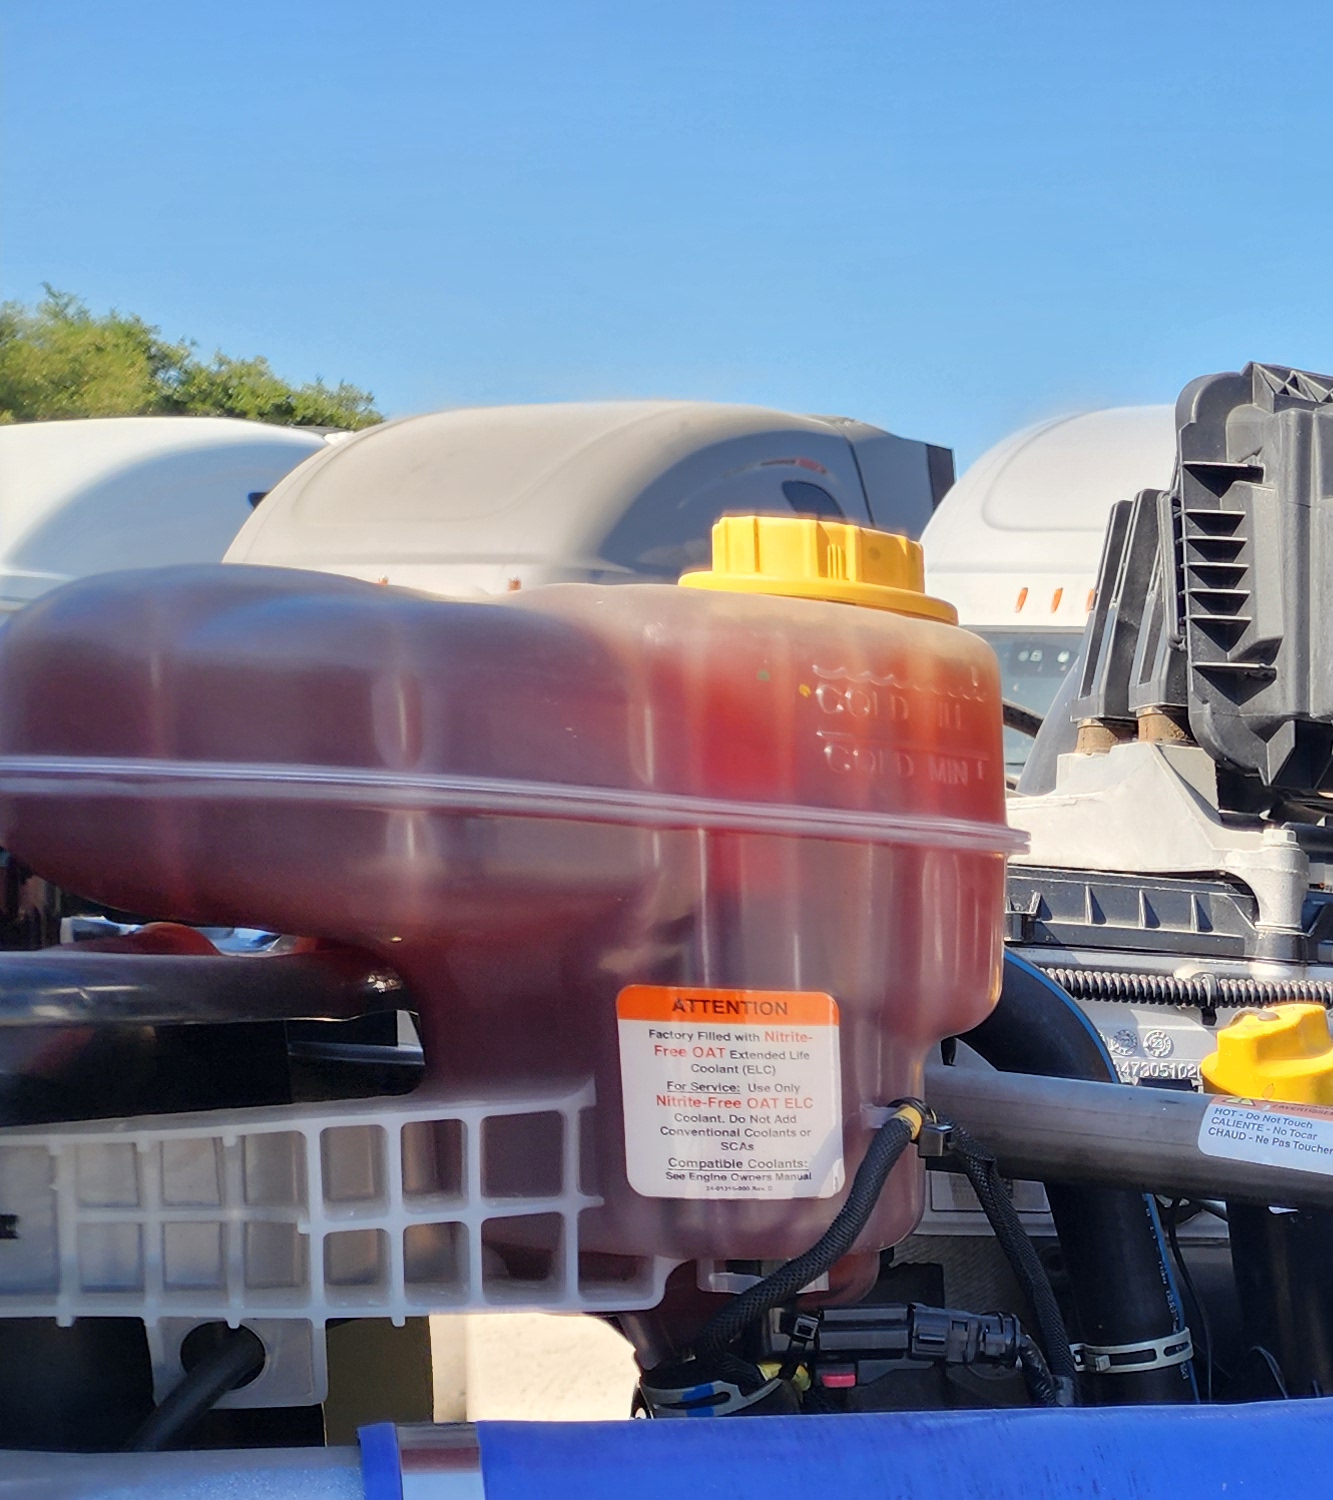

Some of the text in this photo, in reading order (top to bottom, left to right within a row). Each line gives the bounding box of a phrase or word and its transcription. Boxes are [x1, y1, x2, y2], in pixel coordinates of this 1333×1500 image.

[927, 754, 969, 787] MIN
[672, 998, 788, 1016] ATTENTION
[648, 1029, 813, 1044] Factory Filled with Nitrite-
[653, 1044, 810, 1061] Free OAT Extended Life
[690, 1063, 777, 1077] Coolant (ELC)
[666, 1081, 801, 1095] For Service: Use Only
[655, 1095, 814, 1109] Nitrite-Free OAT ELC
[674, 1113, 798, 1125] Coolant. Do Not Add
[1214, 1107, 1314, 1129] HOT Do Not Touch
[660, 1126, 812, 1138] Conventional Coolants or
[1211, 1116, 1318, 1141] CALIENTE No Tocar
[1208, 1127, 1247, 1141] CHAUD
[1255, 1134, 1270, 1145] Ne
[1272, 1137, 1291, 1148] Pas
[720, 1142, 755, 1151] SCAs
[667, 1158, 809, 1171] Compatible Coolants:
[665, 1171, 812, 1183] See Engine Owners Manual
